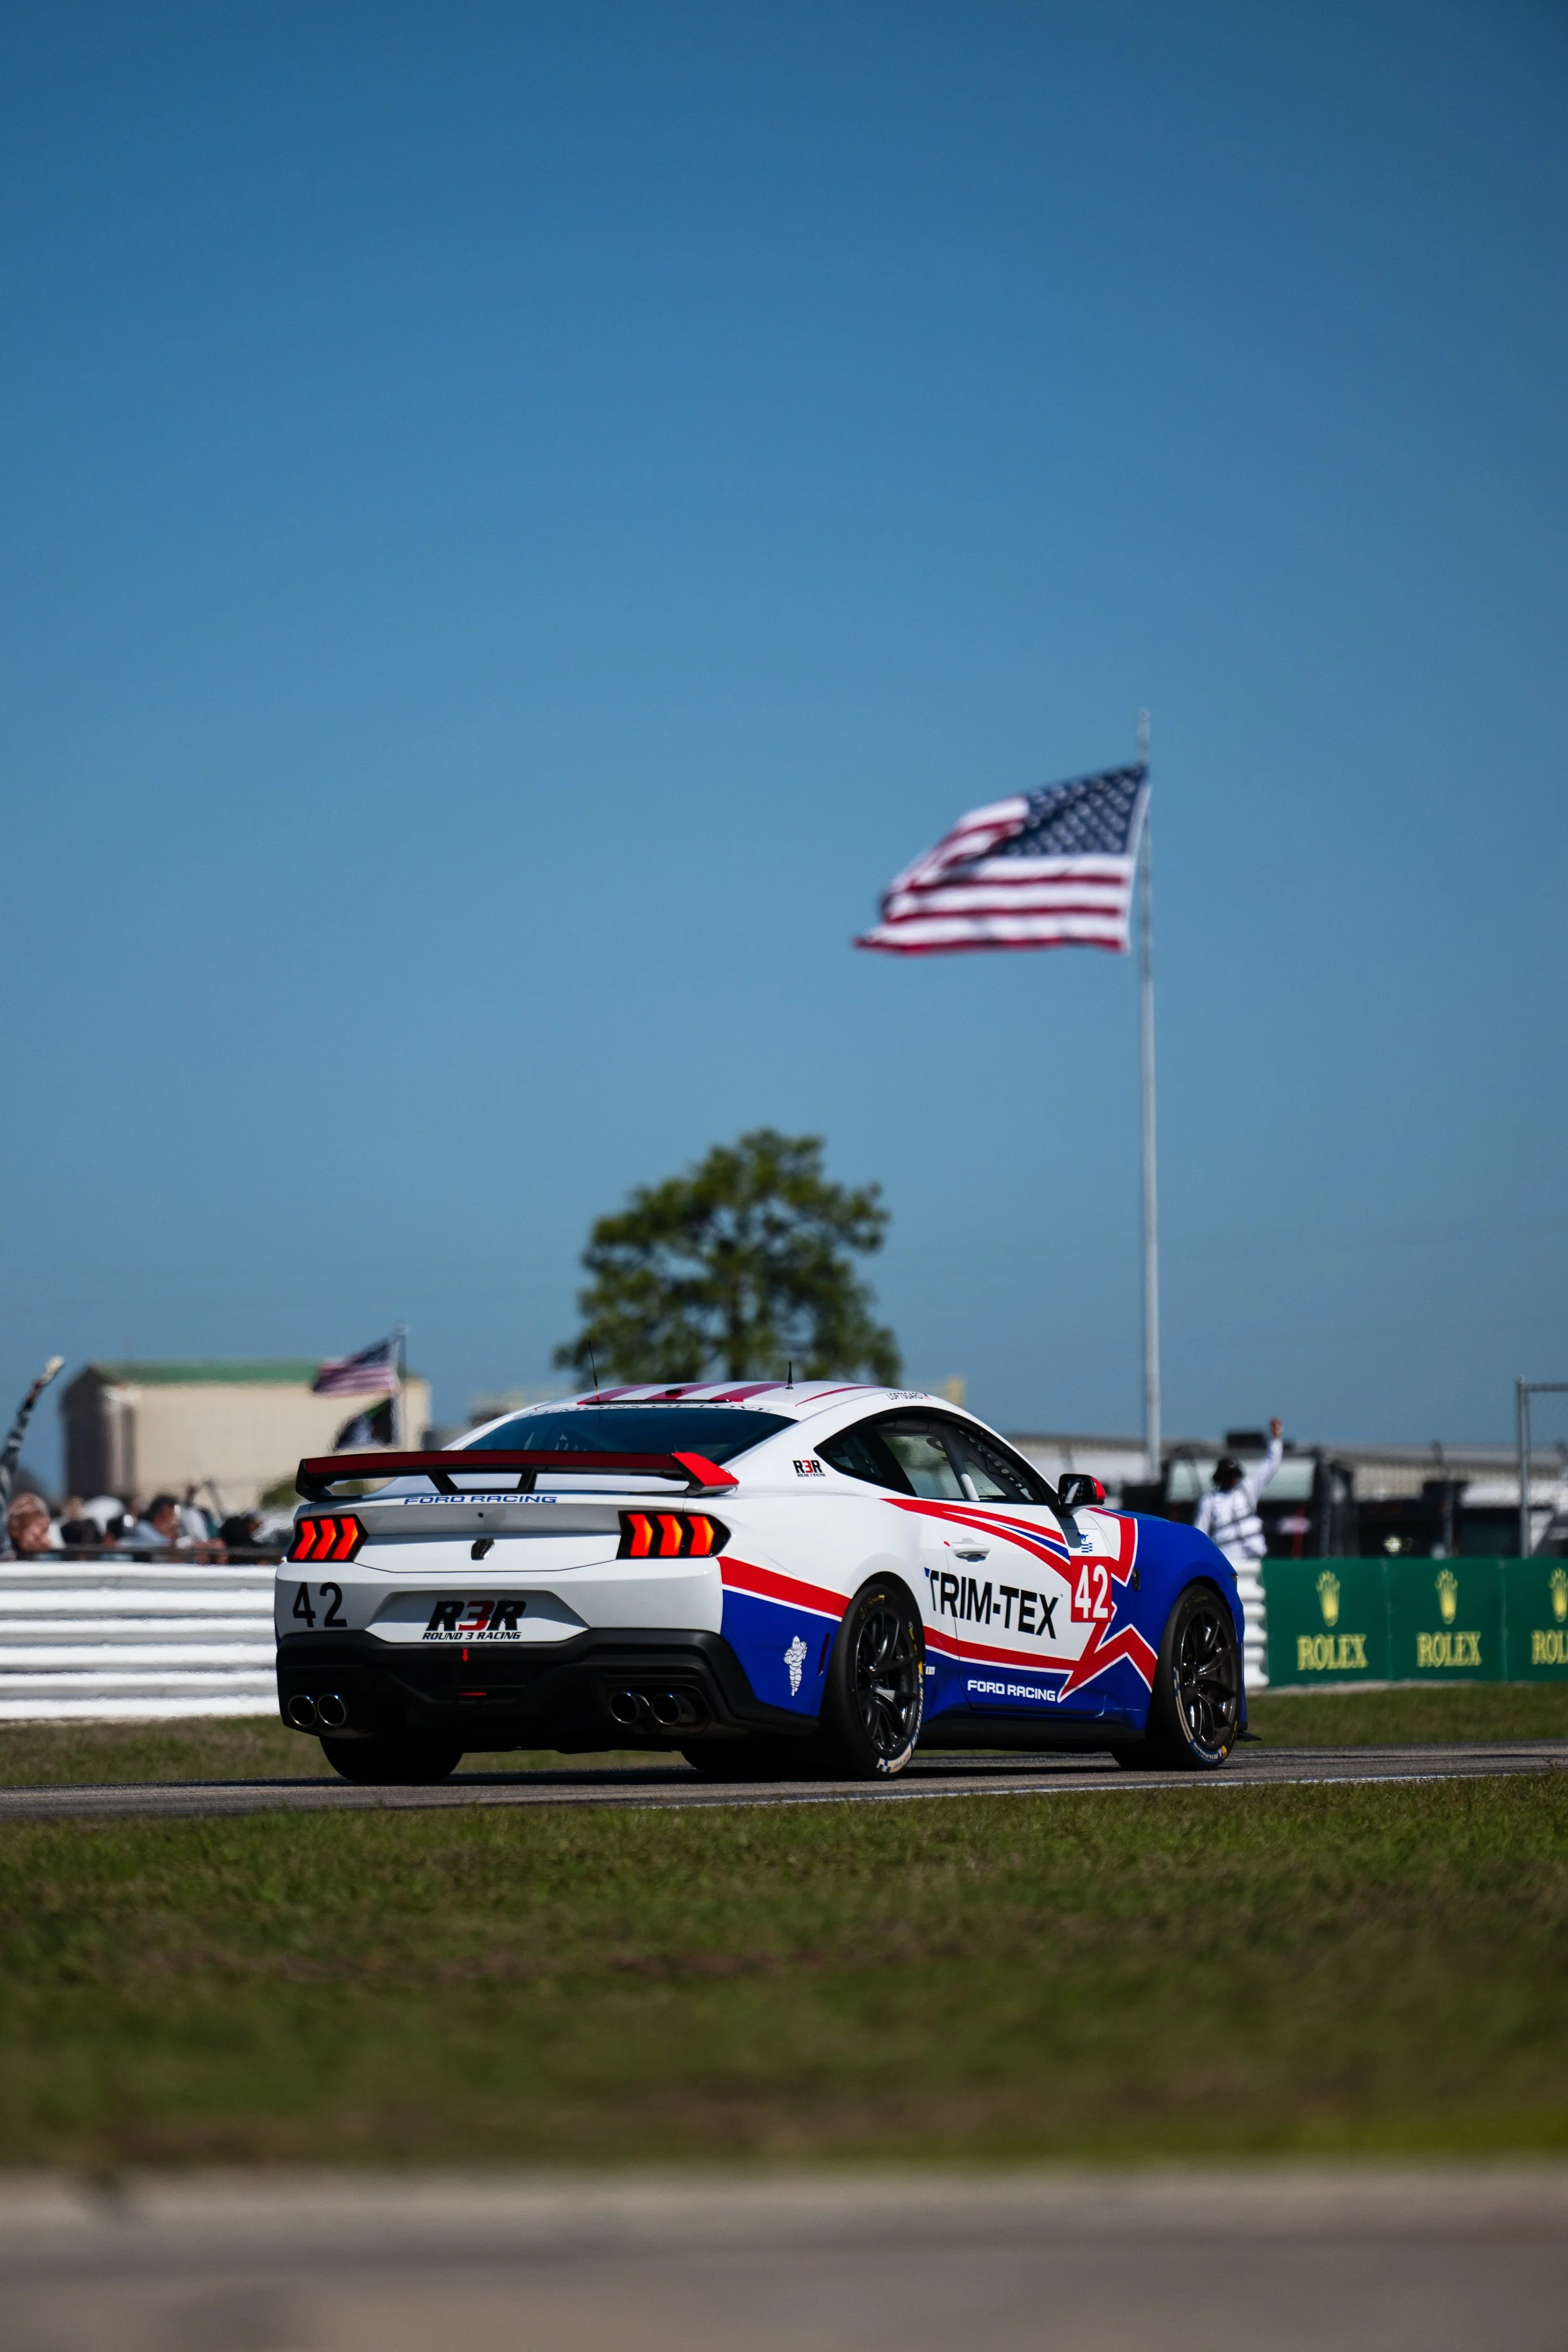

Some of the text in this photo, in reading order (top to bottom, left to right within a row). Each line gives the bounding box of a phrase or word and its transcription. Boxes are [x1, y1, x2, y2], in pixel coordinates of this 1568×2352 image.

[792, 1459, 824, 1474] R3R
[404, 1495, 557, 1505] FORD RACING
[293, 1582, 347, 1628] 42
[924, 1567, 1059, 1640] TRIM-TEX
[1074, 1564, 1108, 1619] 42
[426, 1601, 526, 1631] R3R
[422, 1631, 463, 1640] ROUND
[476, 1631, 522, 1640] RACING
[1297, 1633, 1369, 1671] ROLEX
[1416, 1631, 1483, 1668] ROLEX
[1531, 1629, 1568, 1665] ROL
[967, 1680, 1056, 1702] FORD RACING
